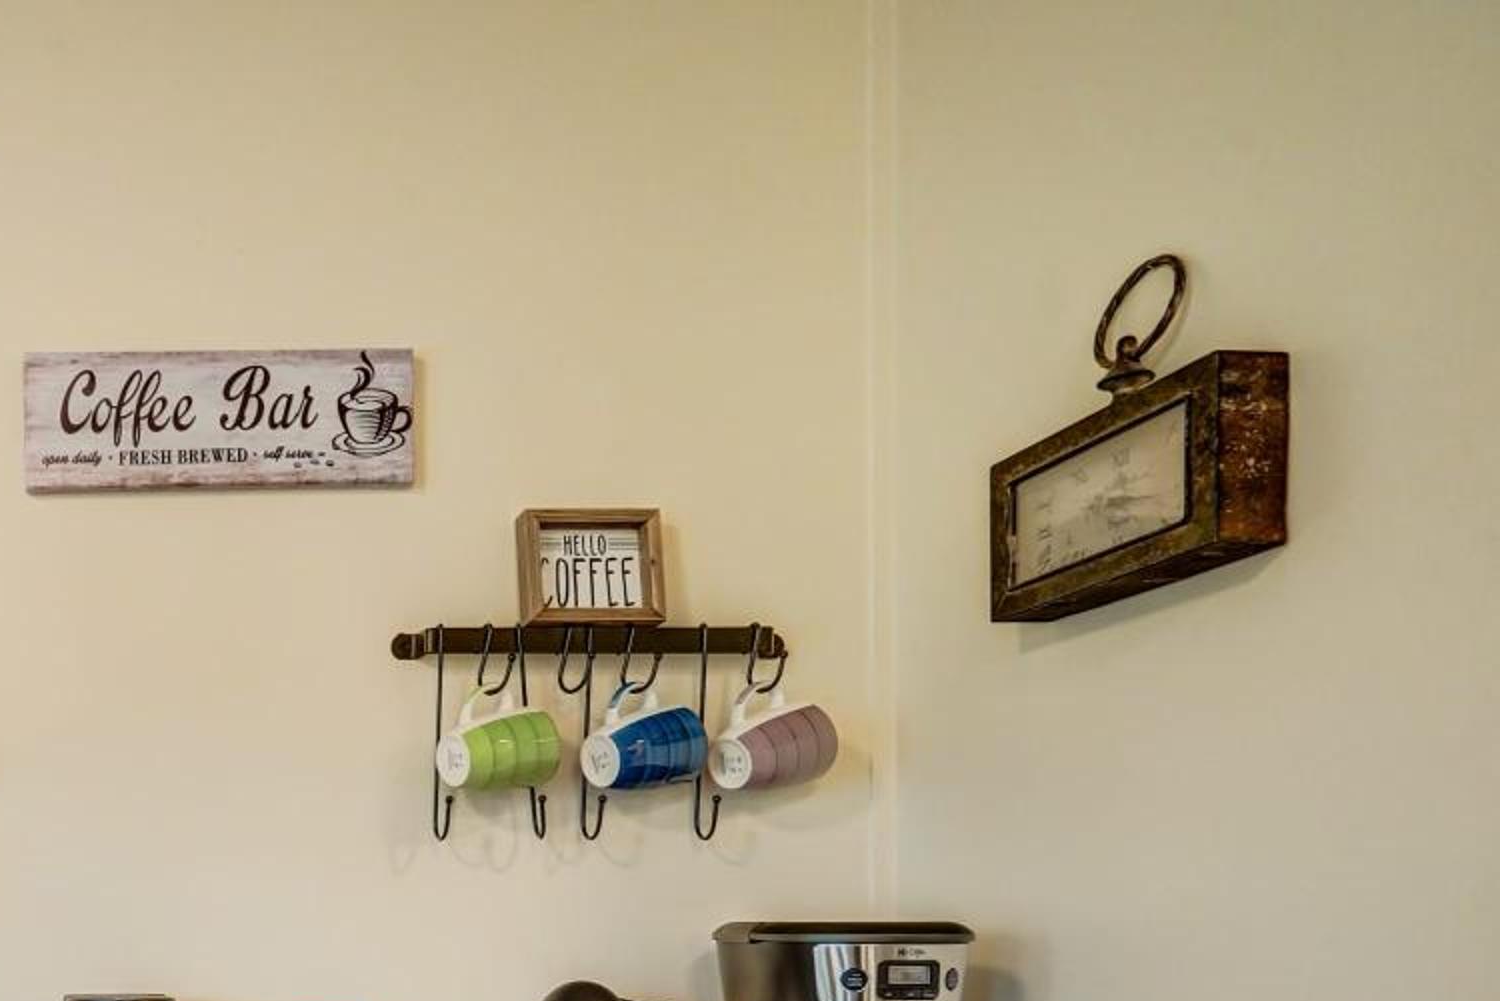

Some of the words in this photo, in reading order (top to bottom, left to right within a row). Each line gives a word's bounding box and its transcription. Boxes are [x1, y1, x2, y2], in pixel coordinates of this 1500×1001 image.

[59, 369, 198, 448] Coffee
[219, 364, 319, 432] Bar
[41, 454, 70, 467] open
[71, 450, 103, 467] daily
[118, 449, 172, 466] FRESH
[177, 447, 249, 465] BREWED
[262, 446, 285, 462] self
[563, 534, 608, 556] HELLO
